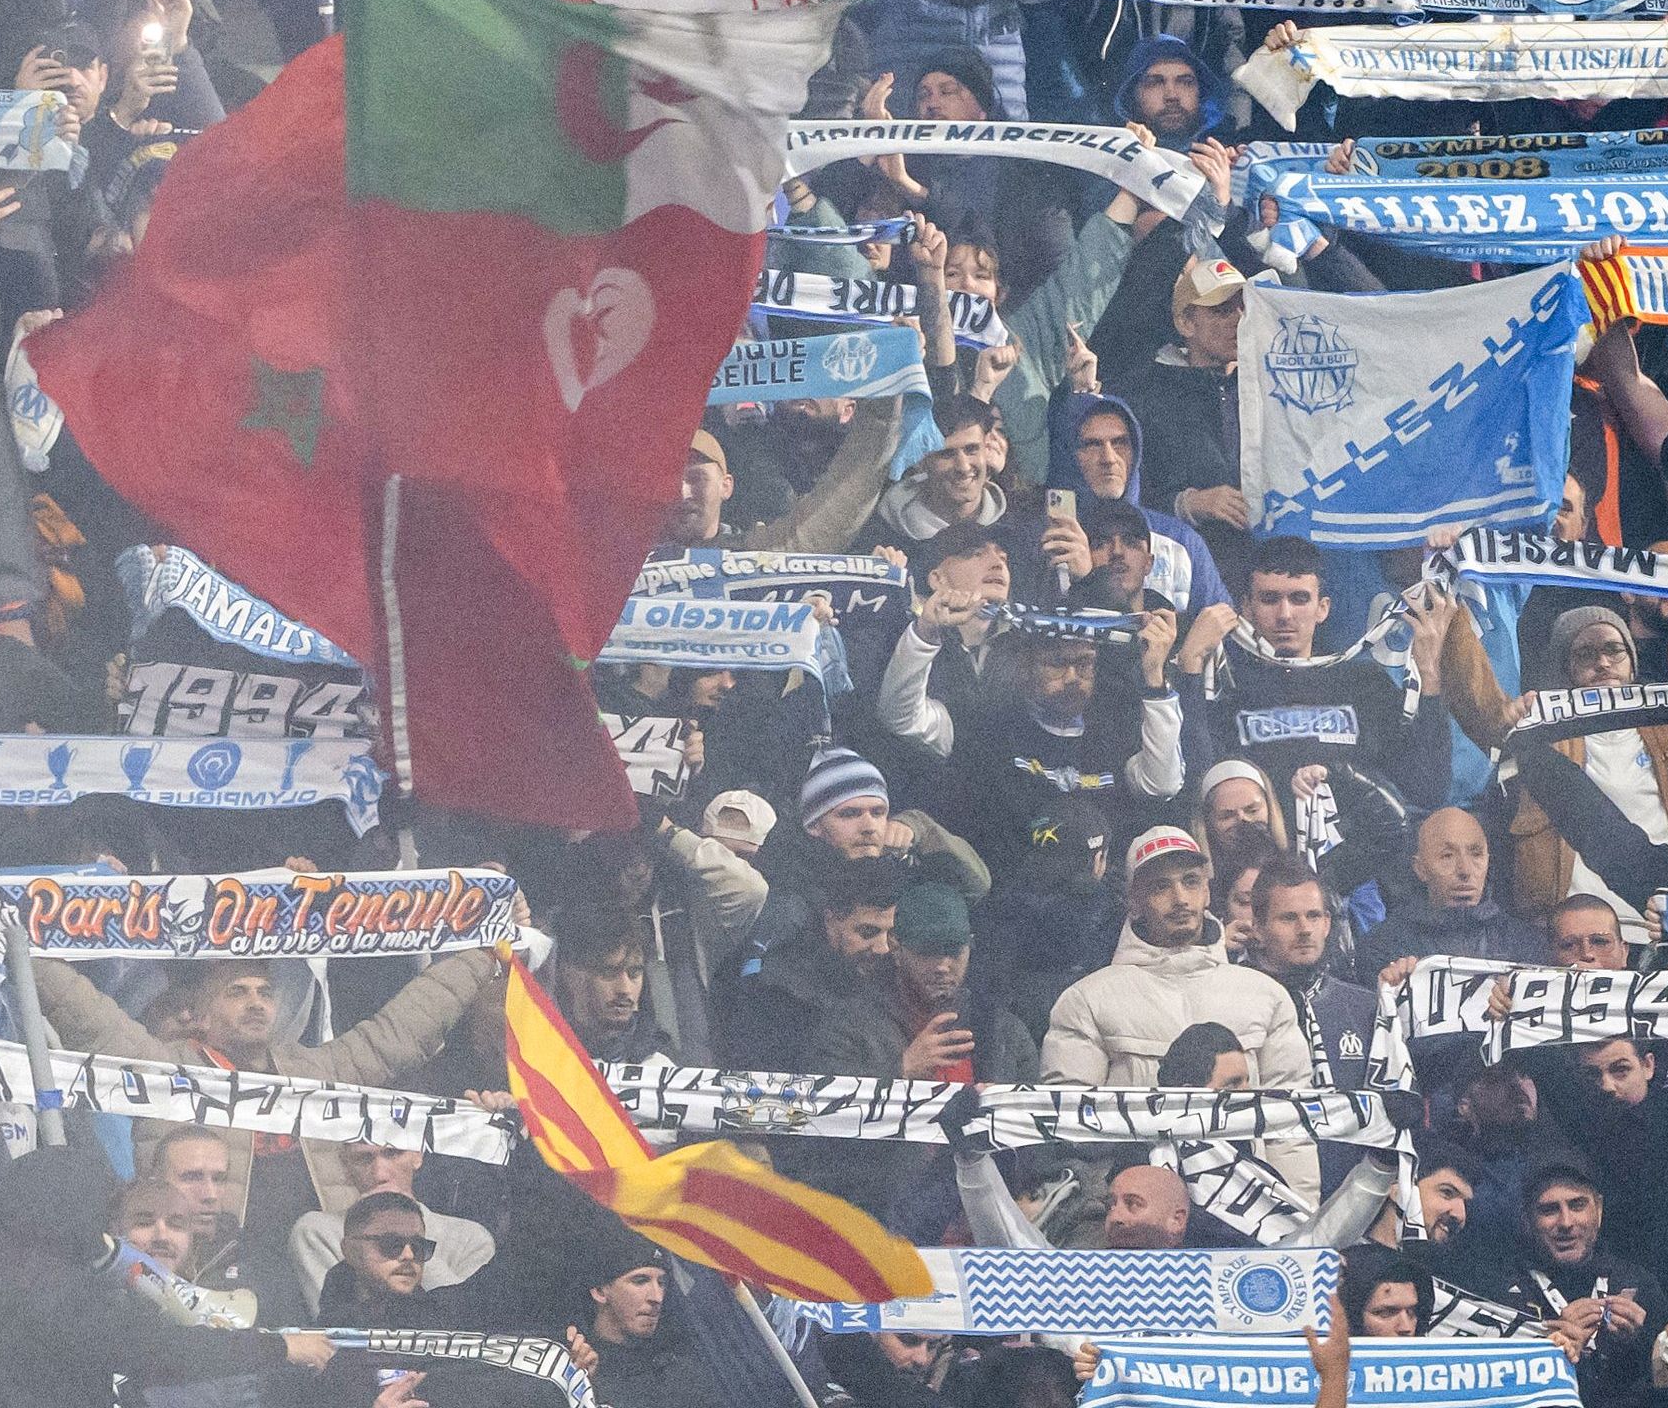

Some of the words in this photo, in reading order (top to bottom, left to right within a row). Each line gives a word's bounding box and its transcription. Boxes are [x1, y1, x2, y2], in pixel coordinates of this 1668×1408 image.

[1339, 46, 1482, 73] OLYMPIQUE
[1375, 133, 1581, 158] OLYMPIQUE
[1339, 191, 1537, 234] ALLEZ
[172, 553, 317, 658] JAMAIS
[29, 876, 160, 946] Paris
[208, 879, 279, 938] On
[382, 922, 444, 952] mort
[1095, 1358, 1312, 1394] OLYMPIQUE
